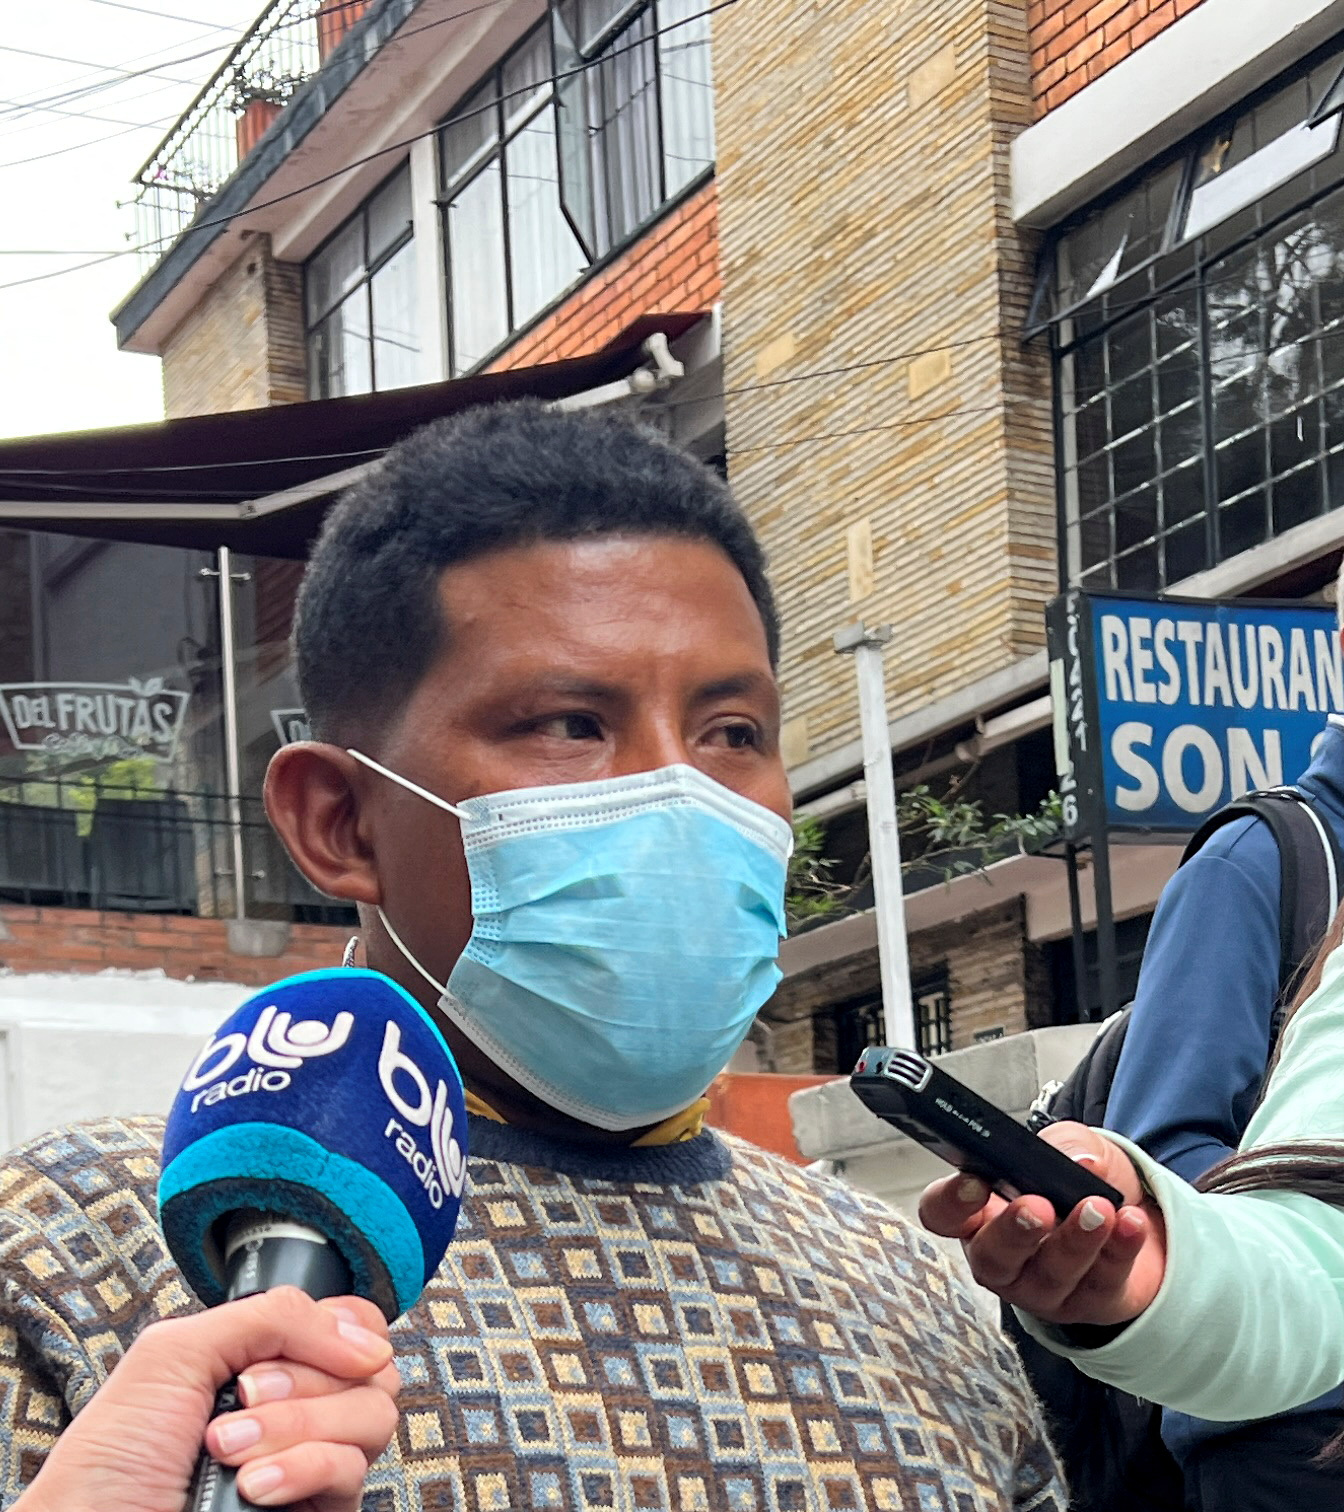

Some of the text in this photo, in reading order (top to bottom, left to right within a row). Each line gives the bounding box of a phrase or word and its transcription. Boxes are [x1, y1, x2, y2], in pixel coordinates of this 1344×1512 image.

[10, 693, 173, 744] DEL FRUTAS
[1110, 721, 1284, 814] SON
[181, 1004, 355, 1092] blu
[190, 1066, 292, 1114] radio
[384, 1118, 443, 1210] radio
